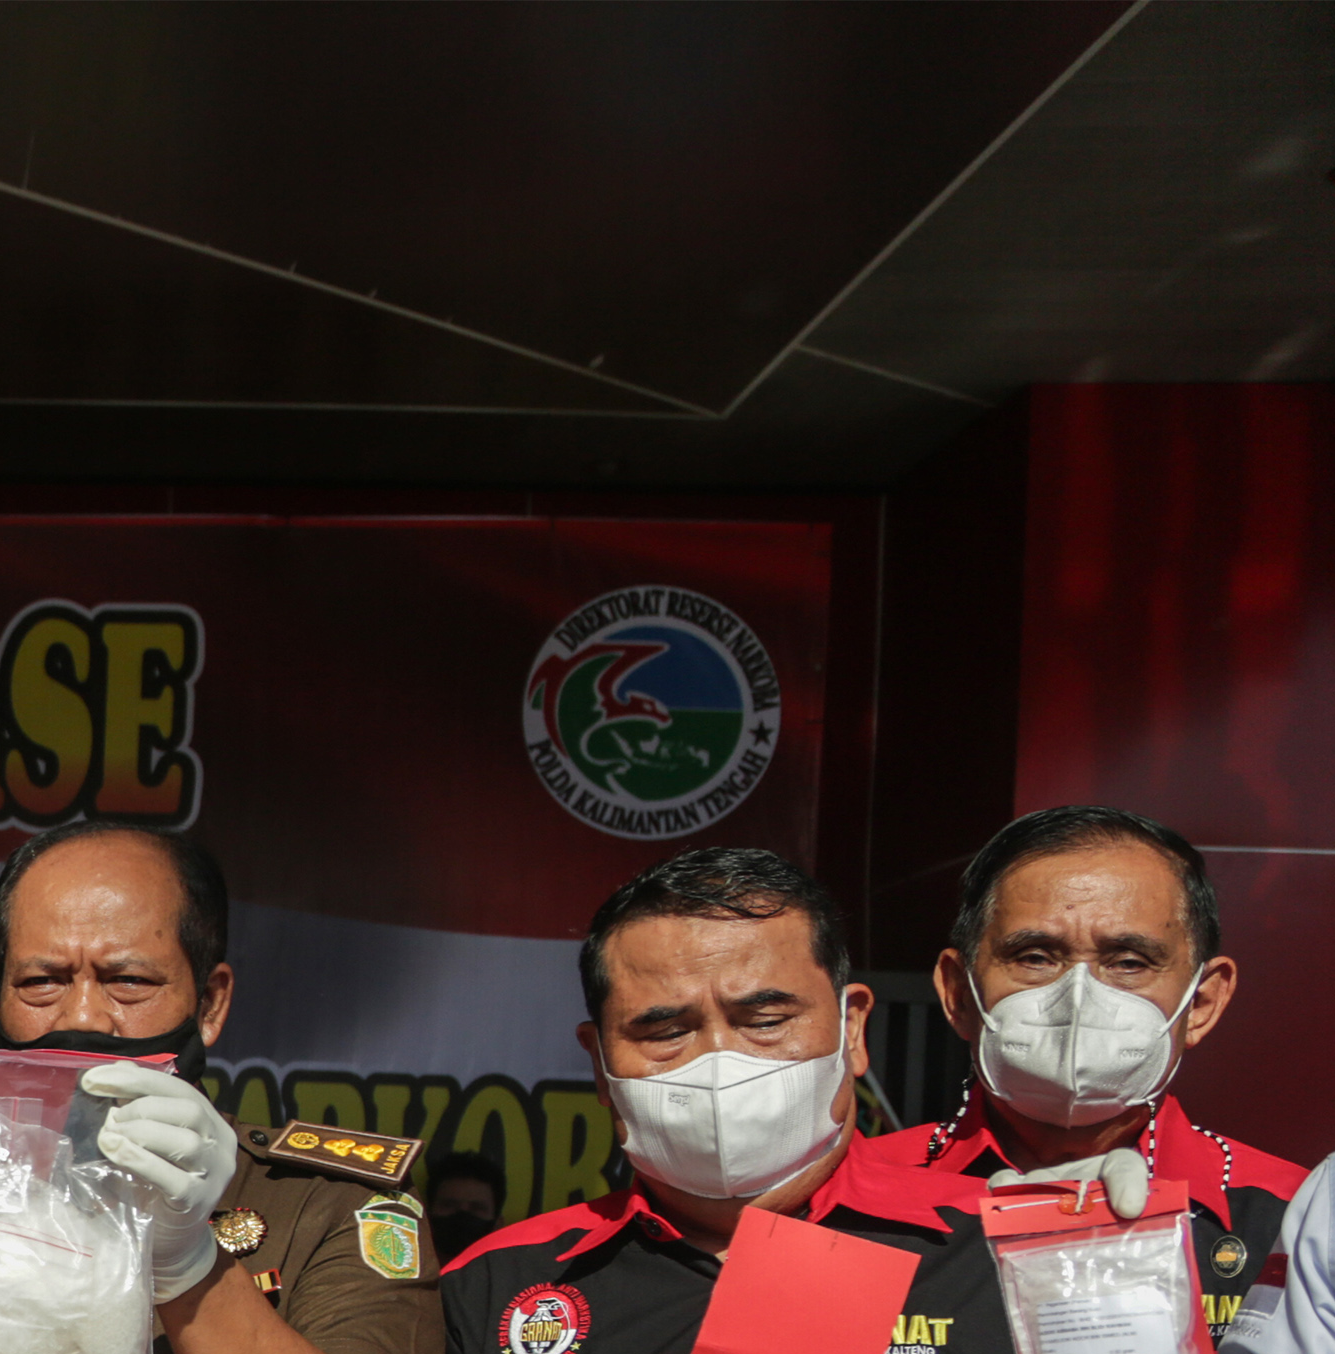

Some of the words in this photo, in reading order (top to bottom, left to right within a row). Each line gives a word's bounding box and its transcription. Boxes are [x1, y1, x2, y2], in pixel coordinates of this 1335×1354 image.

[554, 588, 665, 651] DIREKTORAT
[666, 591, 740, 648] RESERSE
[730, 633, 779, 712] NARKOBA
[530, 740, 575, 803] POLDA
[572, 789, 701, 835] KALIMANTAN
[698, 749, 768, 813] TENGAH
[381, 1143, 411, 1175] JAKSA
[520, 1321, 563, 1342] GRANAT
